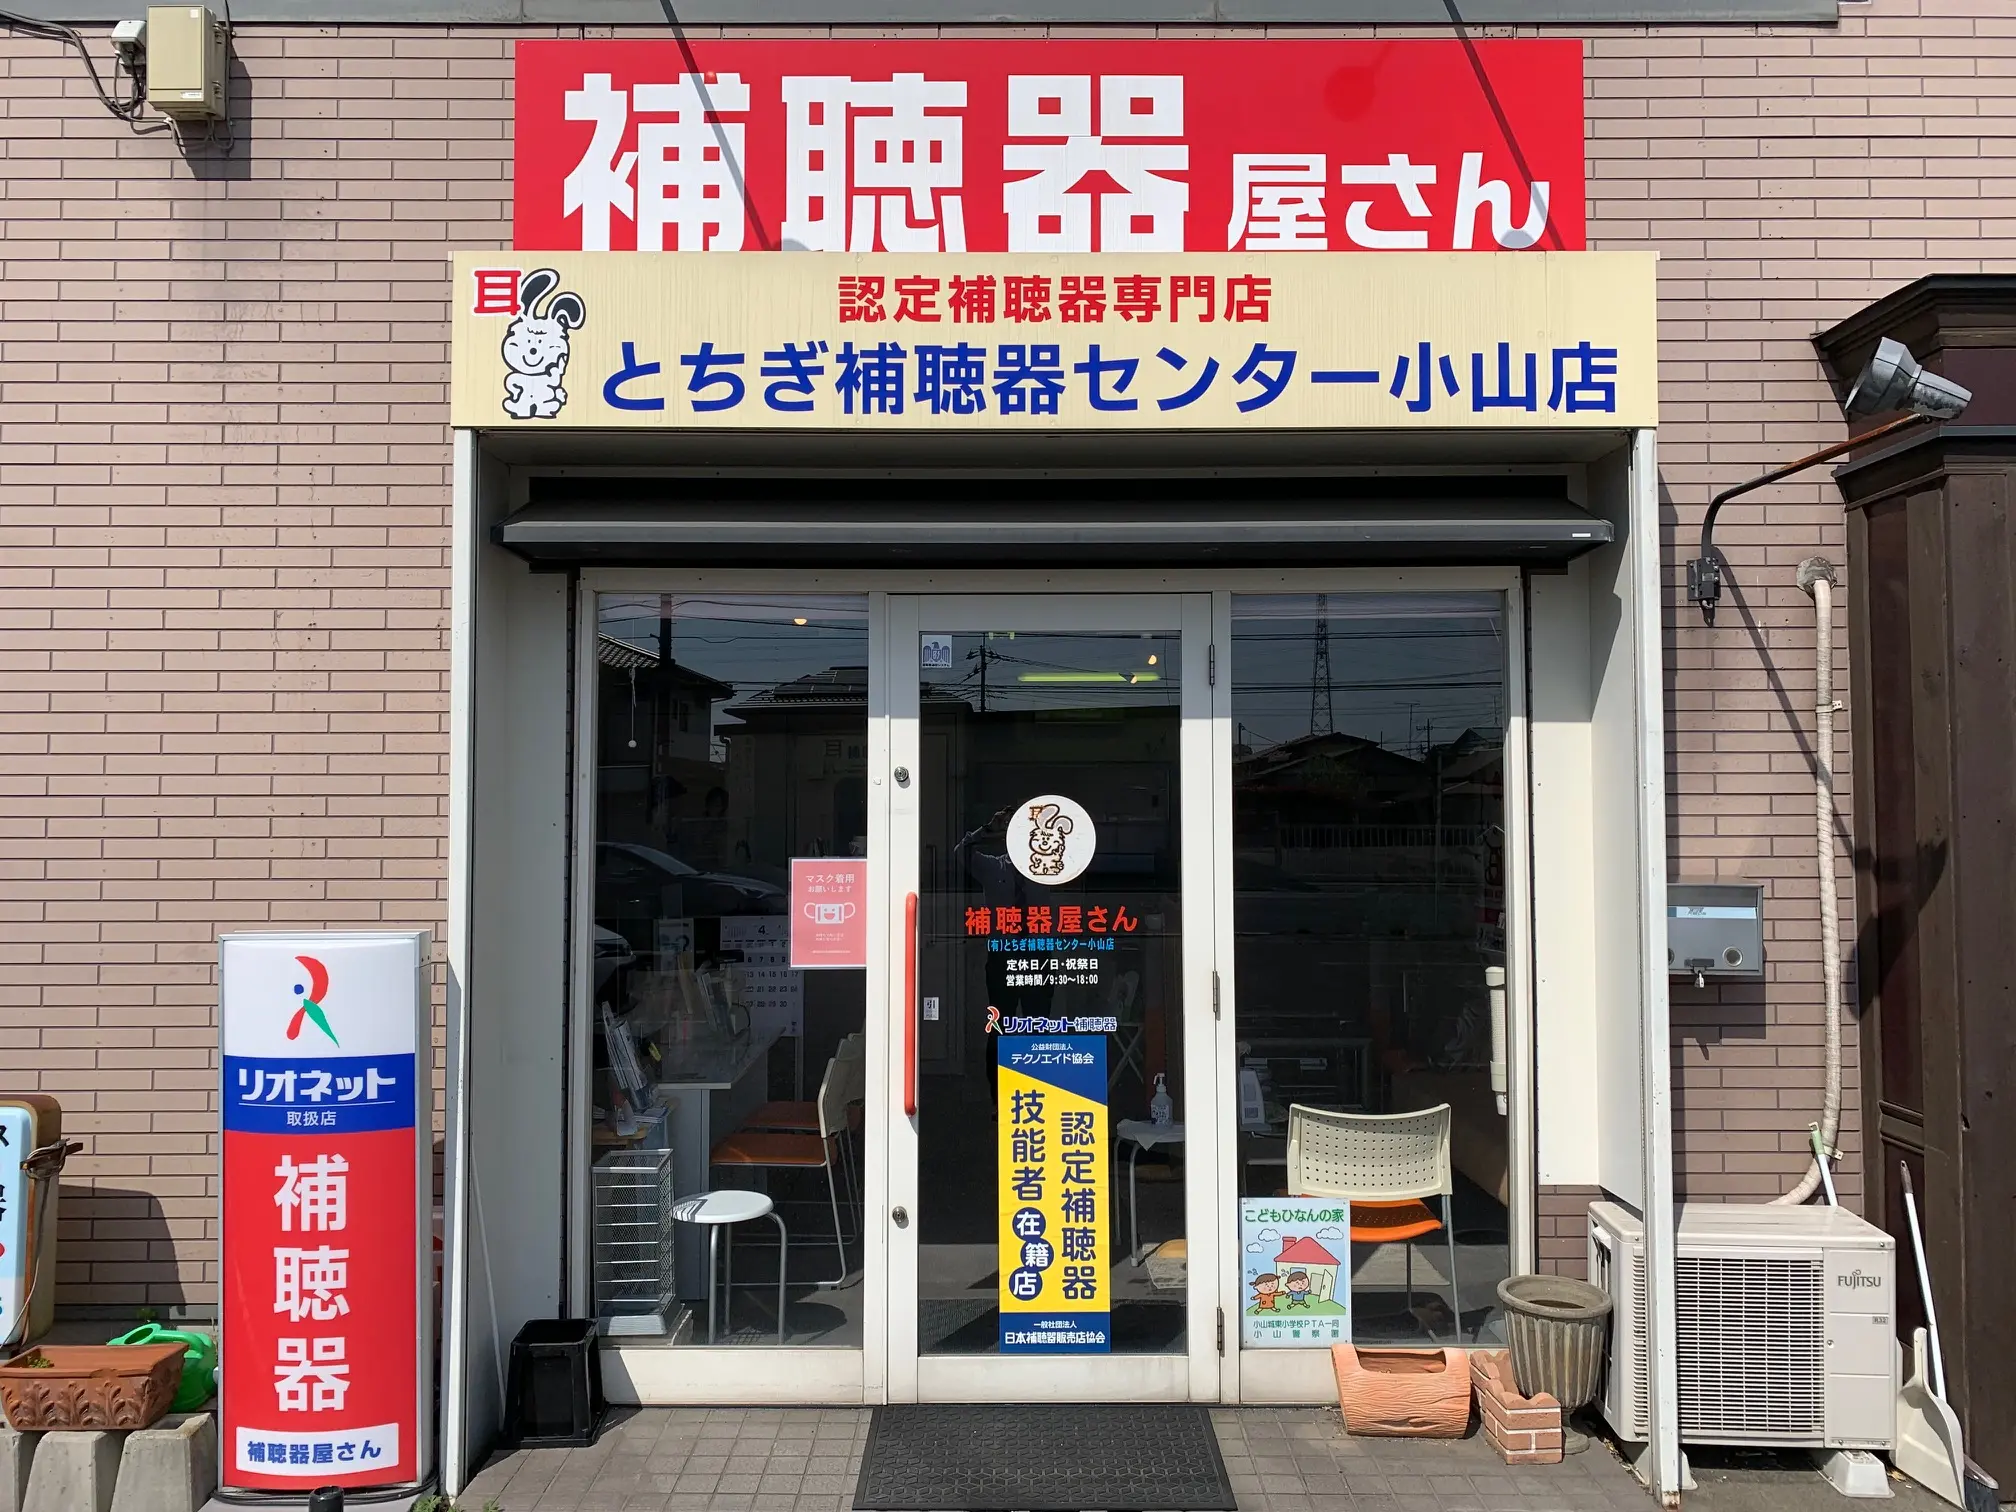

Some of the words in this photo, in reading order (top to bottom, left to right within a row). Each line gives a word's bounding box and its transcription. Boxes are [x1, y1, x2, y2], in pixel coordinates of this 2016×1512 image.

[563, 71, 1552, 252] 補聴器屋さん
[473, 269, 522, 316] 耳
[838, 275, 1273, 324] 認定補聴器専門店
[602, 340, 1619, 415] とちぎ補聴器センター小山店
[805, 873, 856, 884] マスク着用
[807, 885, 852, 893] お願いします
[965, 905, 1138, 935] 補聴器屋さん
[758, 925, 766, 935] 4
[1003, 1016, 1118, 1034] リオネット補聴器
[1030, 1043, 1074, 1051] 公益財団法人
[1011, 1053, 1095, 1065] テクノエイド協会
[238, 1066, 396, 1103] リオネット
[286, 1110, 338, 1128] 取扱店
[1060, 1111, 1098, 1300] 認定補聴器
[1244, 1208, 1345, 1223] こどもひなんの家
[273, 1153, 351, 1414] 補聴器
[1837, 1269, 1881, 1289] FUJITSU
[1033, 1321, 1078, 1329] 一般社団法人
[1005, 1333, 1106, 1345] 日本補聴器販売店協会
[246, 1438, 382, 1466] 補聴器屋さん
